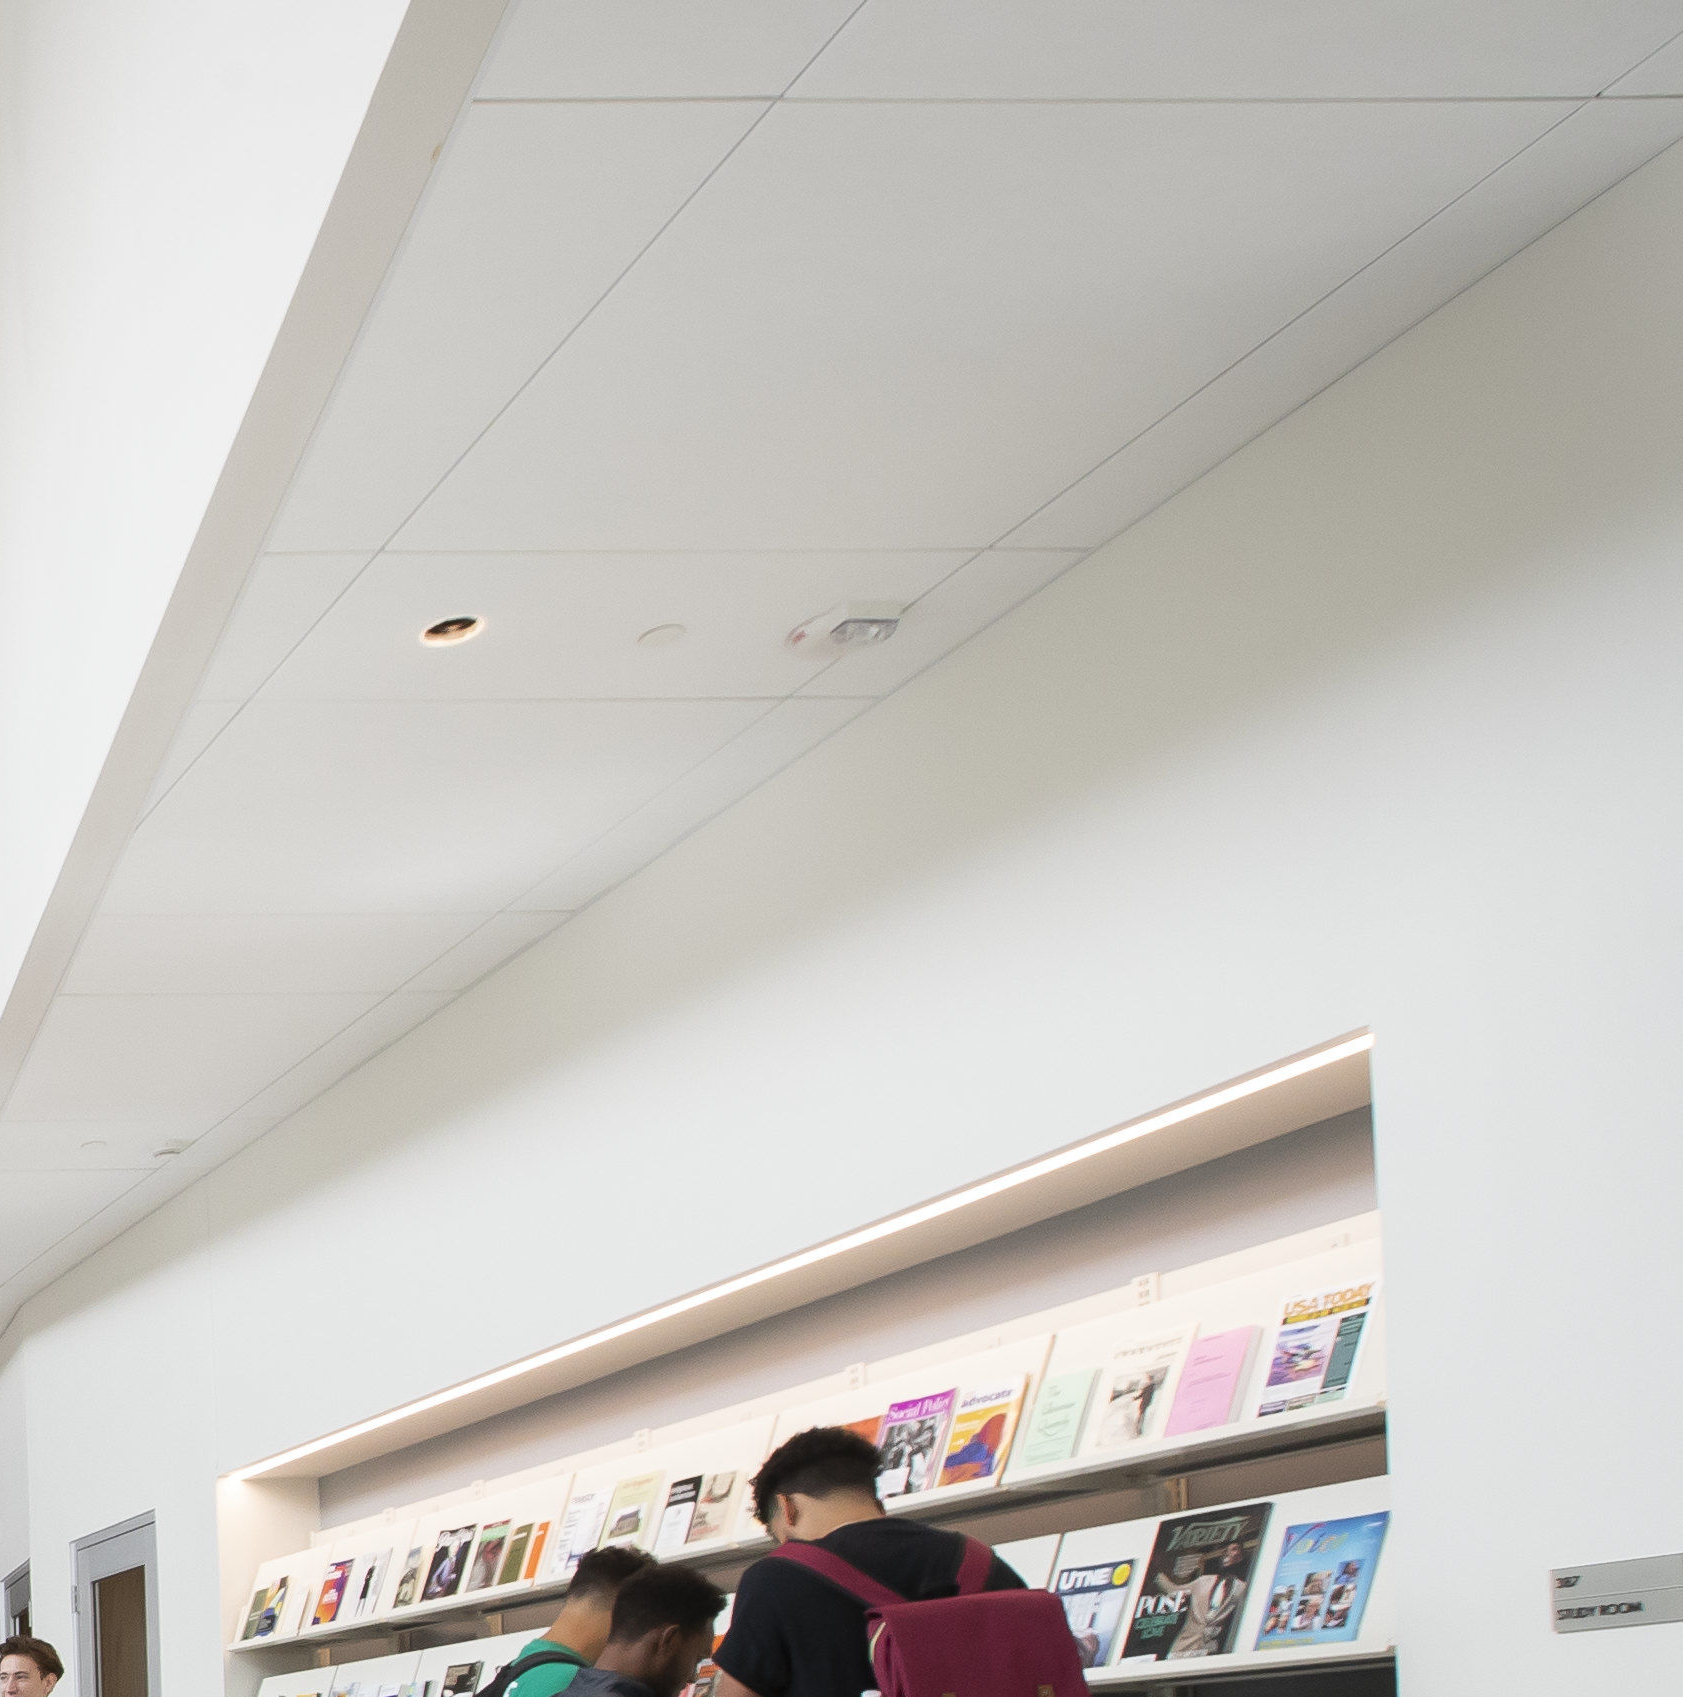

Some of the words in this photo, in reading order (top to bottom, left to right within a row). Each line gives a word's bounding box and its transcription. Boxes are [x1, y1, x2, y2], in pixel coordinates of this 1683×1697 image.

[1283, 1296, 1319, 1317] USA
[1323, 1281, 1375, 1310] TODAY
[1061, 1567, 1113, 1590] UTNE
[1135, 1590, 1191, 1618] POSE
[1598, 1601, 1642, 1616] ROOM
